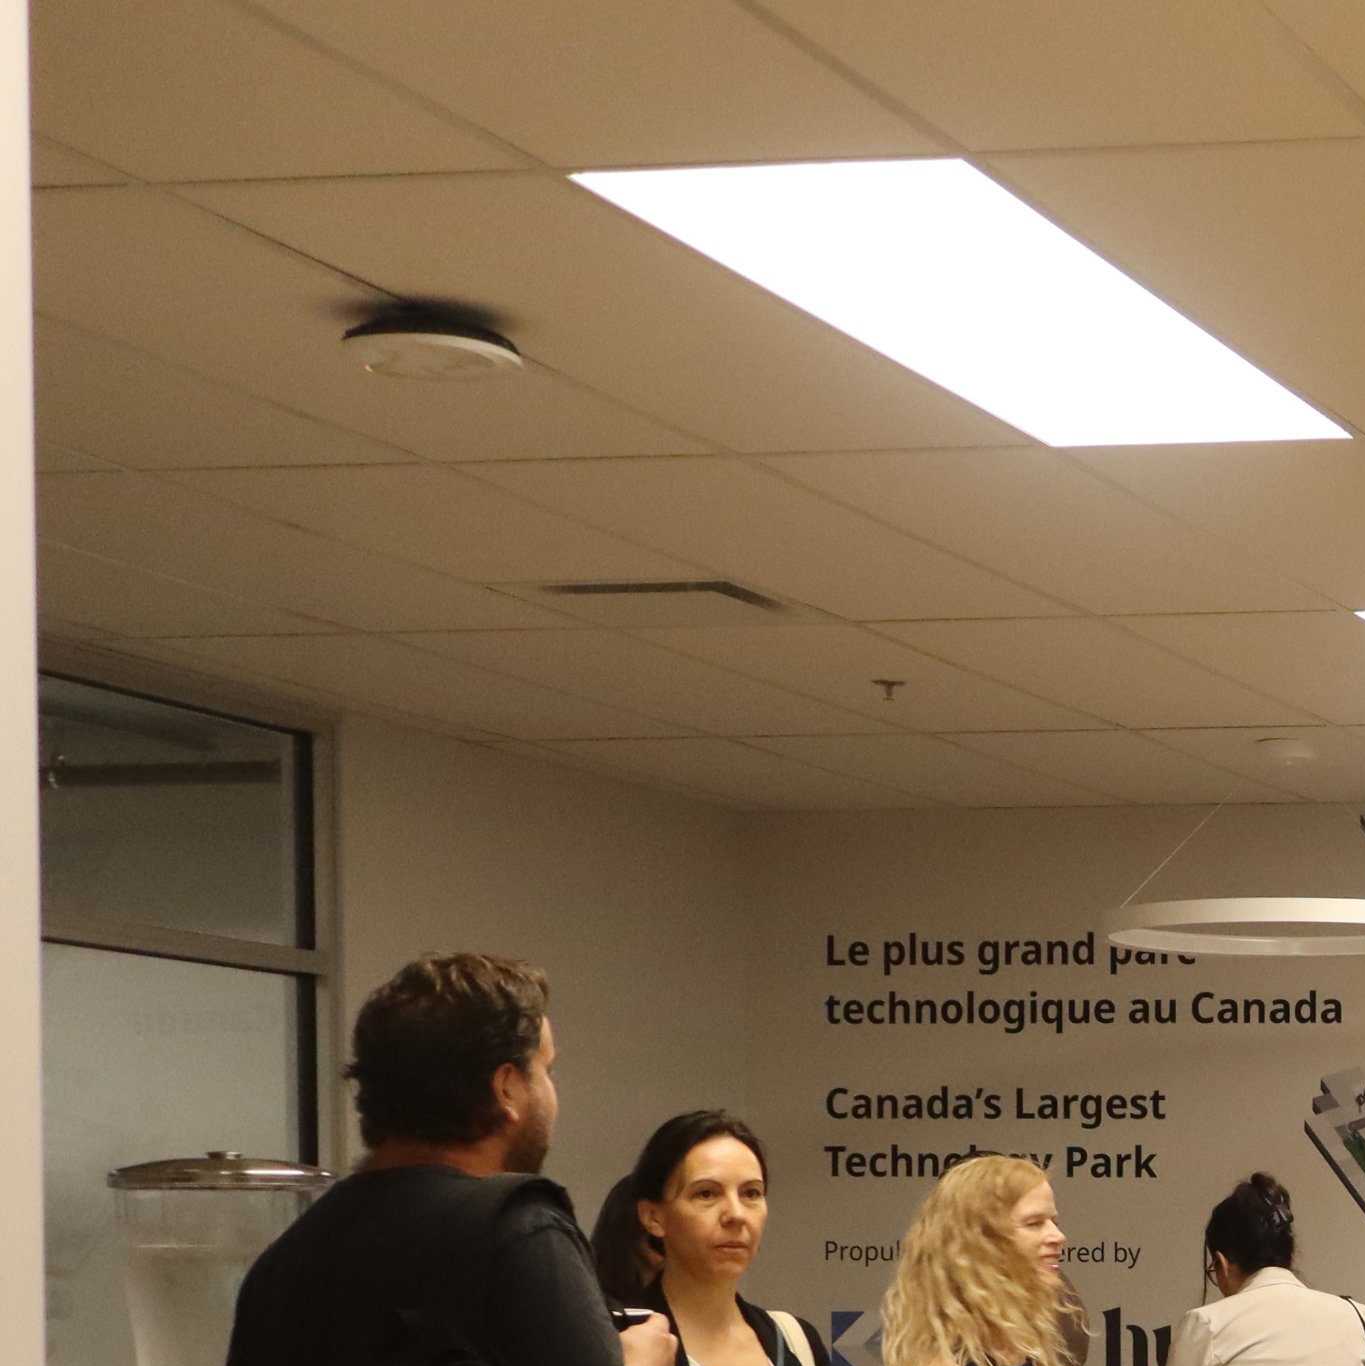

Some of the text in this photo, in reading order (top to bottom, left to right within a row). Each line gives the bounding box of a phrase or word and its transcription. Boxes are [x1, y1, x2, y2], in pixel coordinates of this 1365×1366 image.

[825, 934, 870, 966] Le
[883, 932, 965, 975] plus
[977, 931, 1095, 975] grand
[824, 990, 1342, 1033] technologique au Canada
[1015, 1087, 1166, 1130] Largest
[1066, 1144, 1158, 1178] Park
[1114, 1241, 1141, 1269] by
